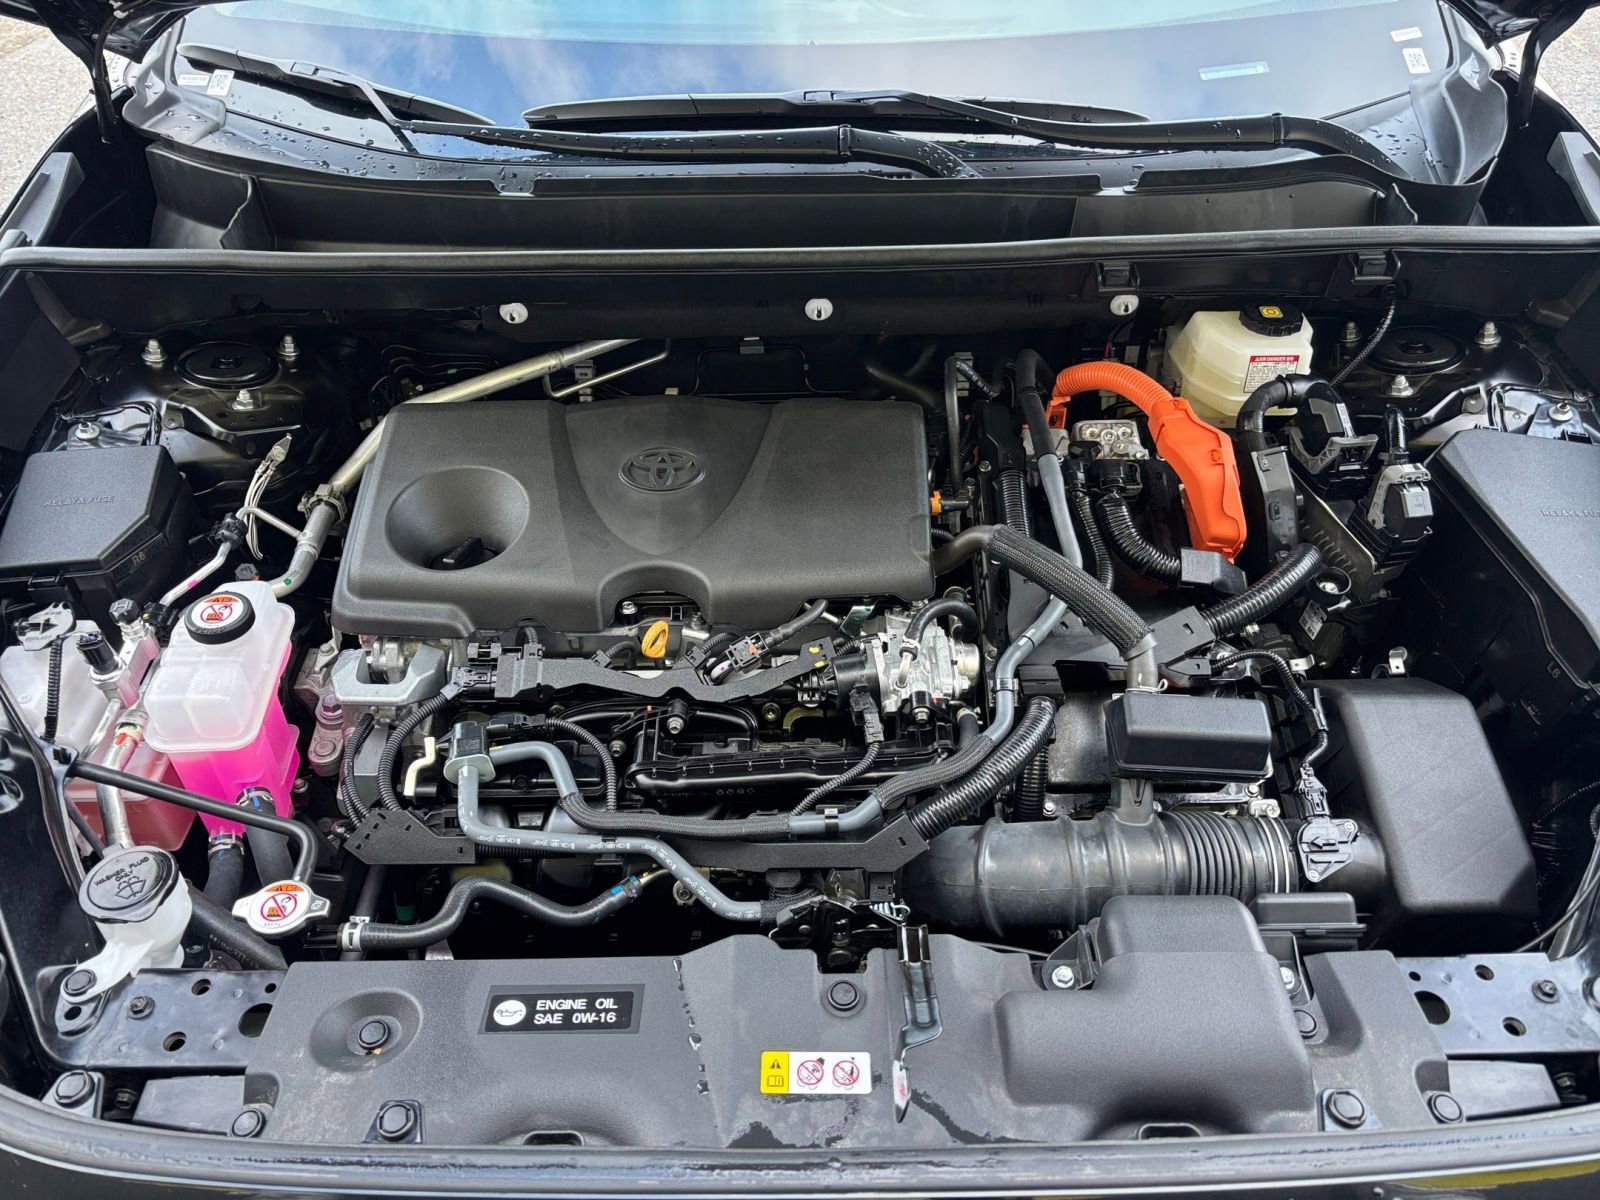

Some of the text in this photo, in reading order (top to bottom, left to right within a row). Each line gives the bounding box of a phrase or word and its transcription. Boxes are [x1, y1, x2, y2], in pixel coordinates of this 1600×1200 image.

[44, 497, 78, 507] RELAY
[86, 495, 116, 504] FUSE
[94, 867, 126, 886] WASHER
[115, 869, 134, 882] ONLY
[535, 997, 618, 1011] ENGINE OIL
[533, 1012, 616, 1025] SAE 0W-16
